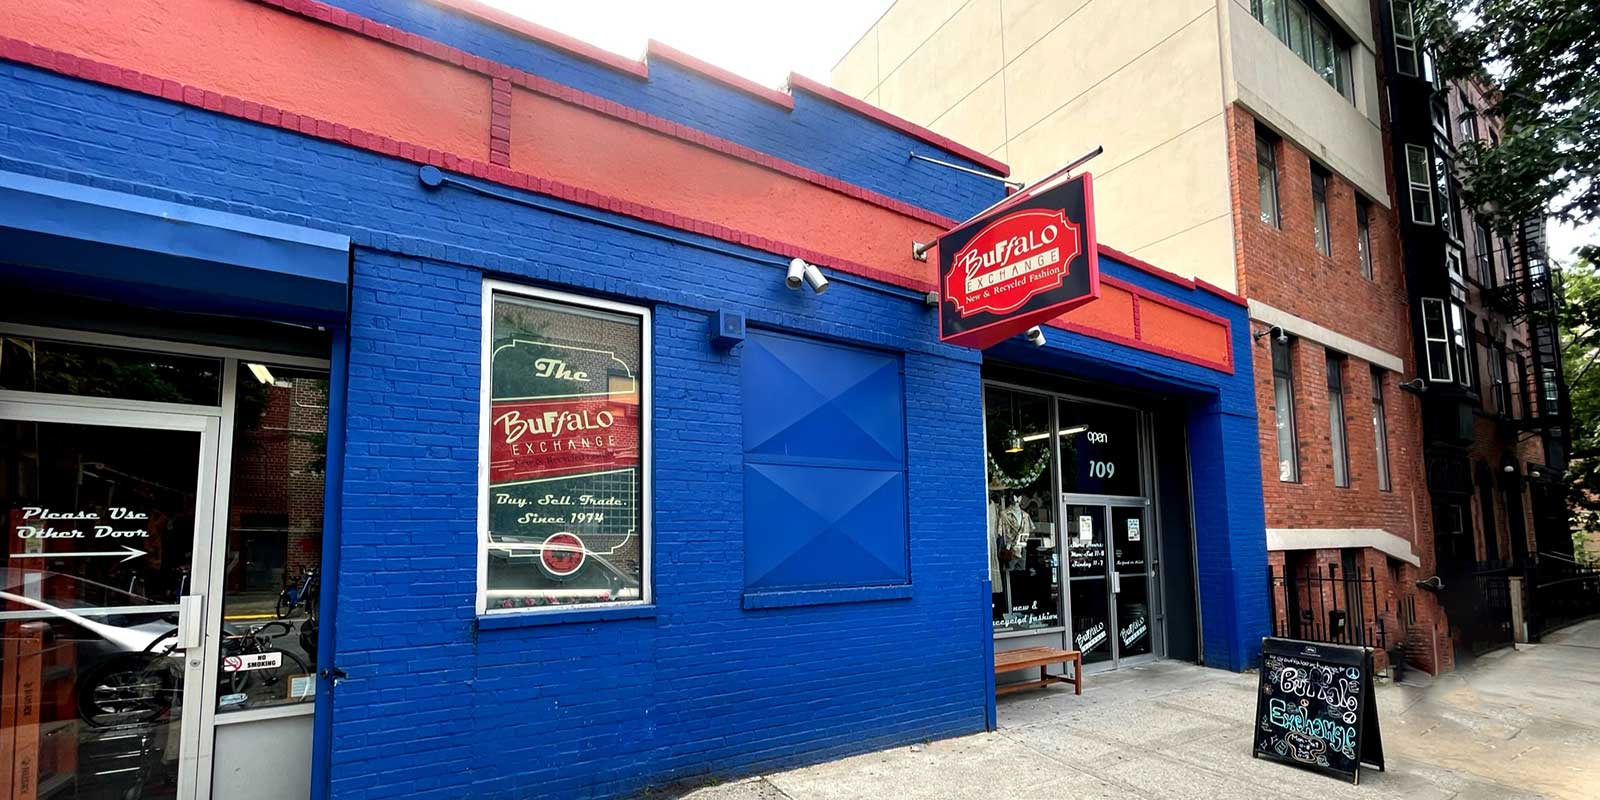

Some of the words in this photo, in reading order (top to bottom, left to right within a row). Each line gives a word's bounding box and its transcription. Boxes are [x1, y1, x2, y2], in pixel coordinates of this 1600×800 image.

[966, 249, 1059, 292] EXCHANGE
[965, 294, 980, 304] New
[983, 290, 990, 298] &
[993, 278, 1026, 295] Recycled
[1029, 267, 1060, 283] Fashion
[534, 358, 590, 382] The
[1087, 431, 1108, 444] open
[512, 434, 616, 456] EXCHANGE
[1089, 460, 1115, 478] 109
[496, 493, 532, 508] Buy.
[537, 494, 575, 506] Sell.
[579, 494, 627, 506] Trade.
[22, 507, 100, 520] Please
[108, 507, 149, 520] Use
[517, 512, 565, 524] Since
[570, 512, 605, 523] 1974
[16, 526, 85, 539] Other
[94, 525, 149, 538] Door
[1031, 600, 1038, 609] &
[1028, 612, 1058, 624] fashion
[247, 660, 276, 668] SMOKING
